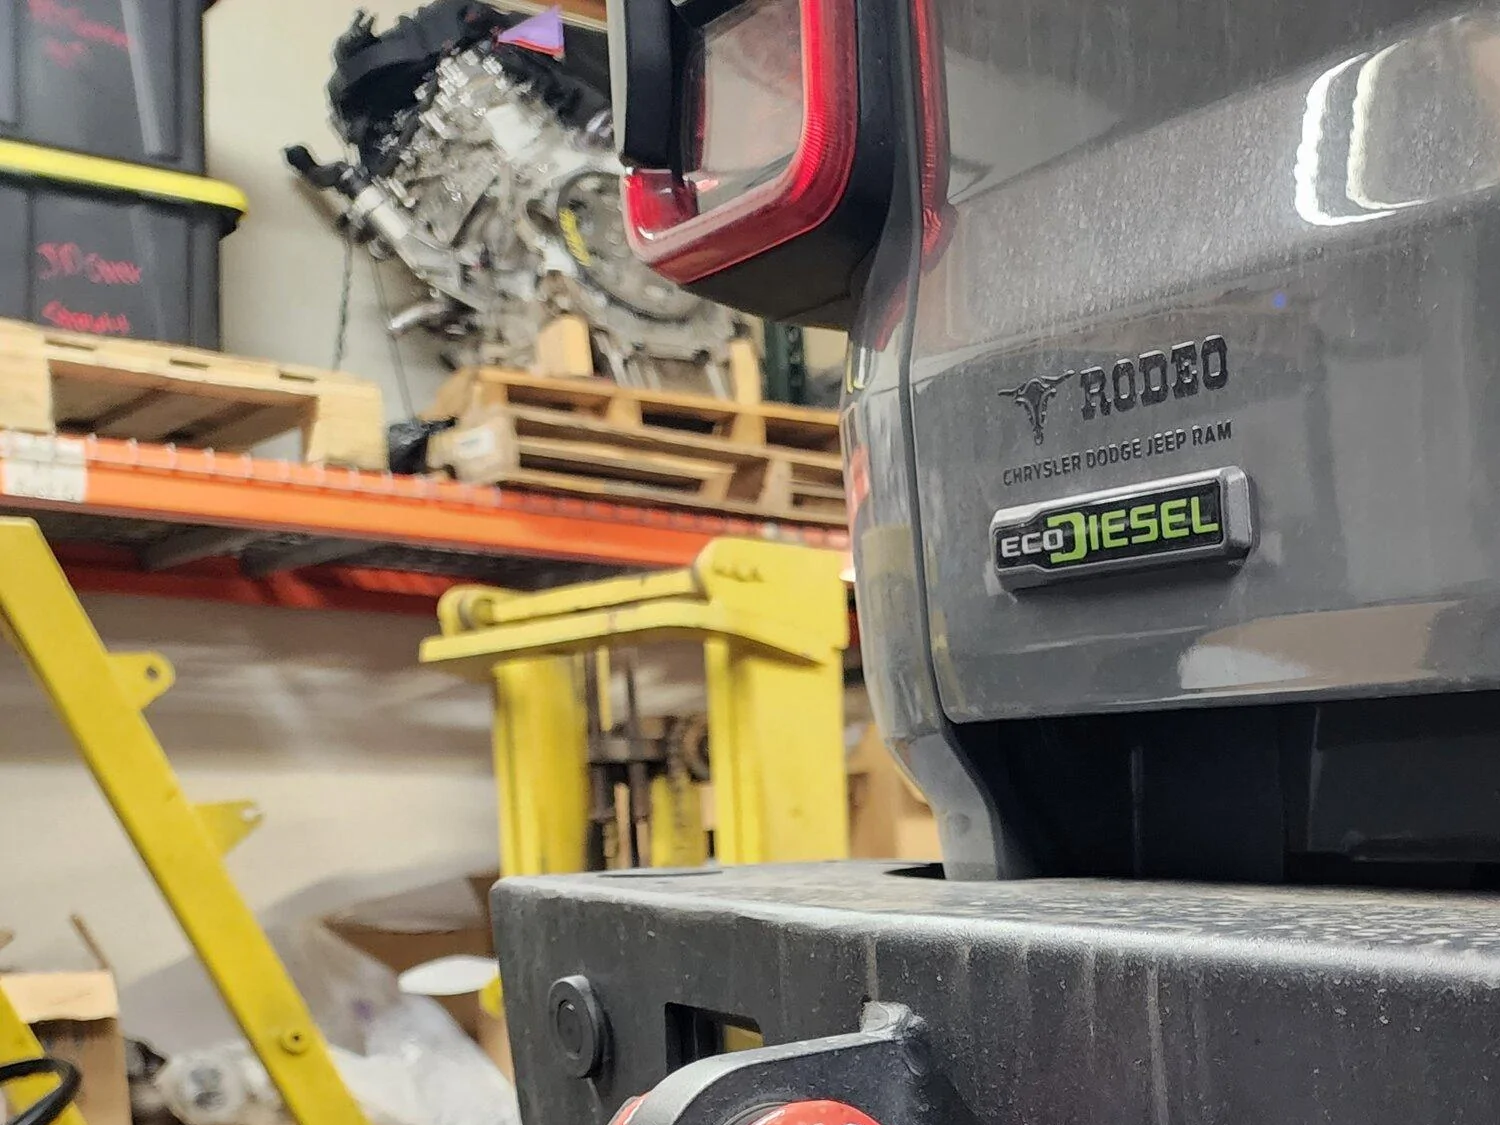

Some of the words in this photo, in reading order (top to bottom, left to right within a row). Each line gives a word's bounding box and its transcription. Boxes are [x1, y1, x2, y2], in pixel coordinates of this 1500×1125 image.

[1080, 334, 1228, 421] RODEO
[1003, 452, 1081, 487] CHRYSLER
[1086, 438, 1141, 469] DODGE
[1146, 429, 1187, 457] JEEP
[1191, 419, 1232, 446] RAM
